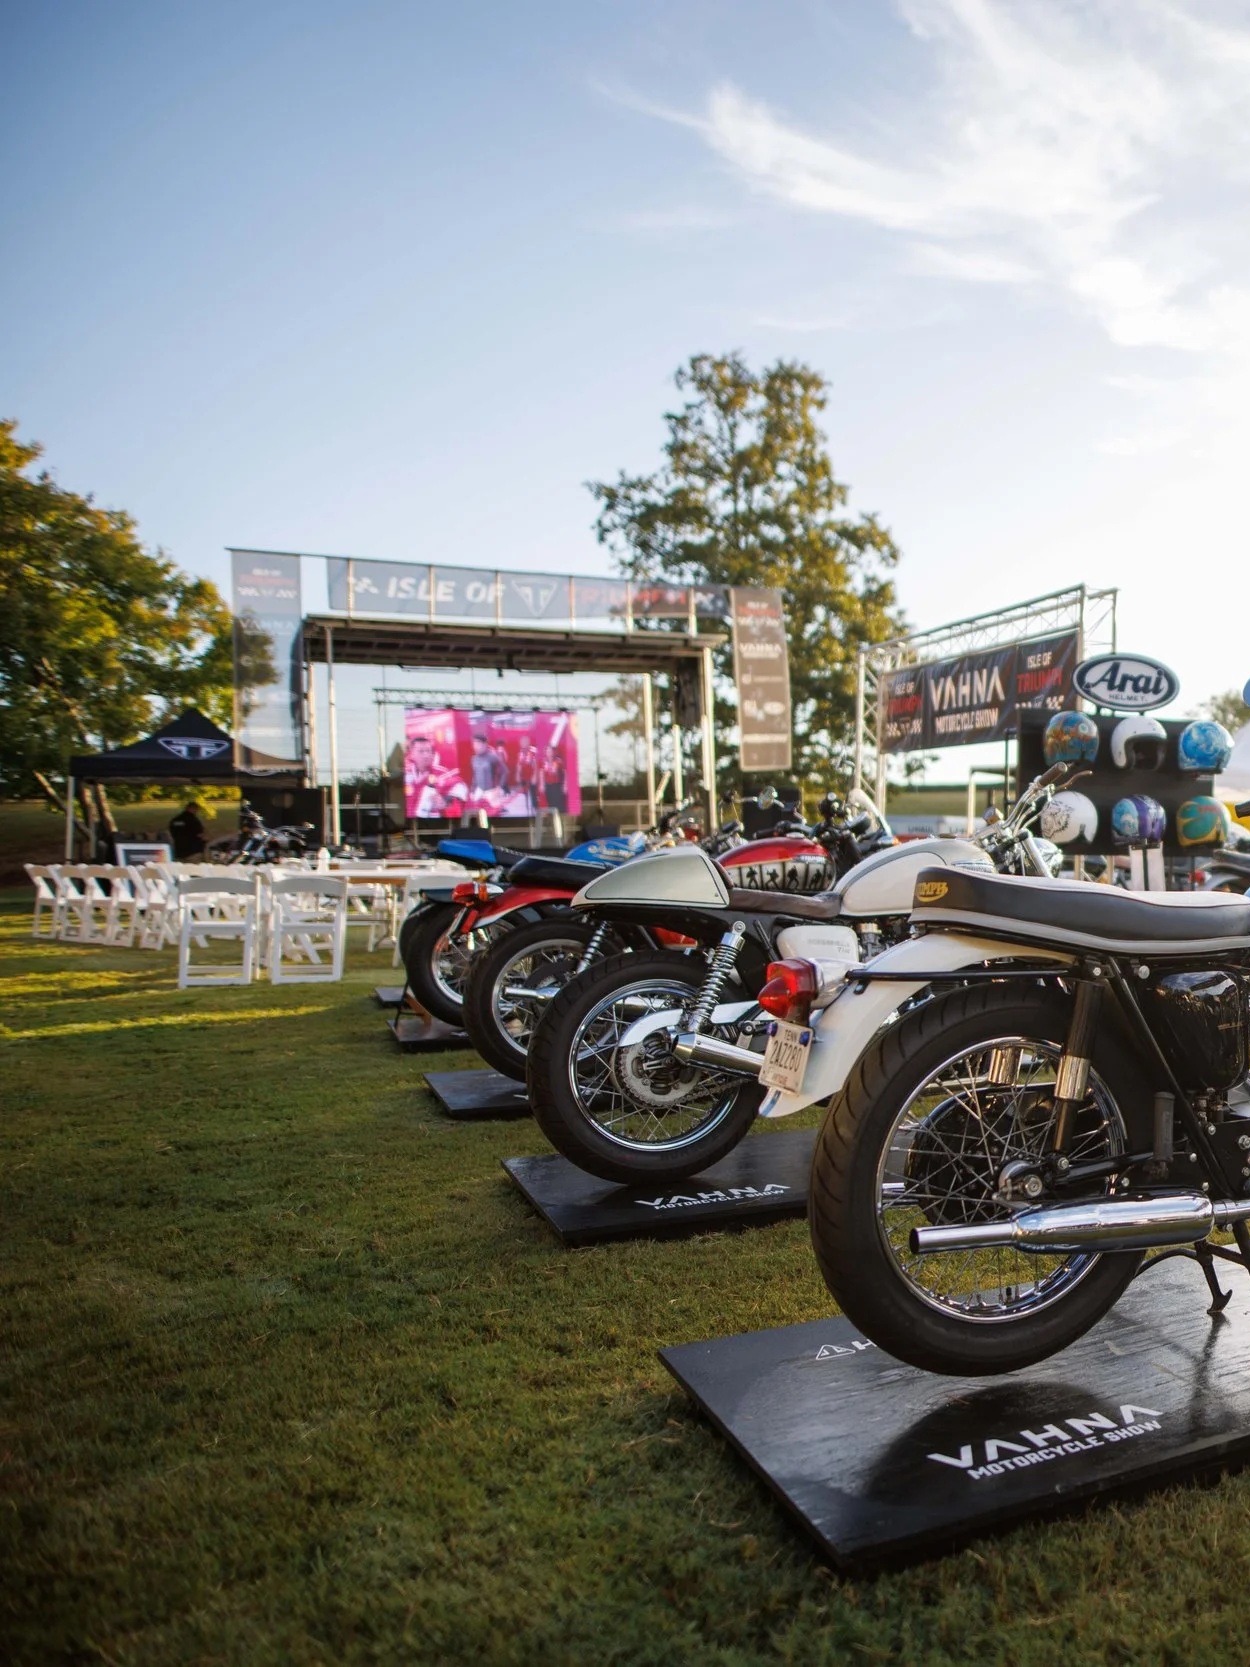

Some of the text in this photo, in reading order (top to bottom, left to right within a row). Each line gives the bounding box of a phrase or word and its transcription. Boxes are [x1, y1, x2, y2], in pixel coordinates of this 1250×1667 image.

[387, 576, 456, 602] ISLE
[465, 581, 506, 604] OF
[1027, 651, 1053, 669] ISLE OF
[931, 665, 1005, 711] VAHNA
[1082, 661, 1165, 695] Arai
[1108, 693, 1146, 701] HELMET
[975, 707, 998, 729] SHOW
[633, 1183, 791, 1206] VAHNA
[653, 1188, 785, 1210] MOTORCYCLE SHOW
[926, 1404, 1164, 1469] VAHNA
[967, 1419, 1162, 1480] MOTORCYCLE SHOW
